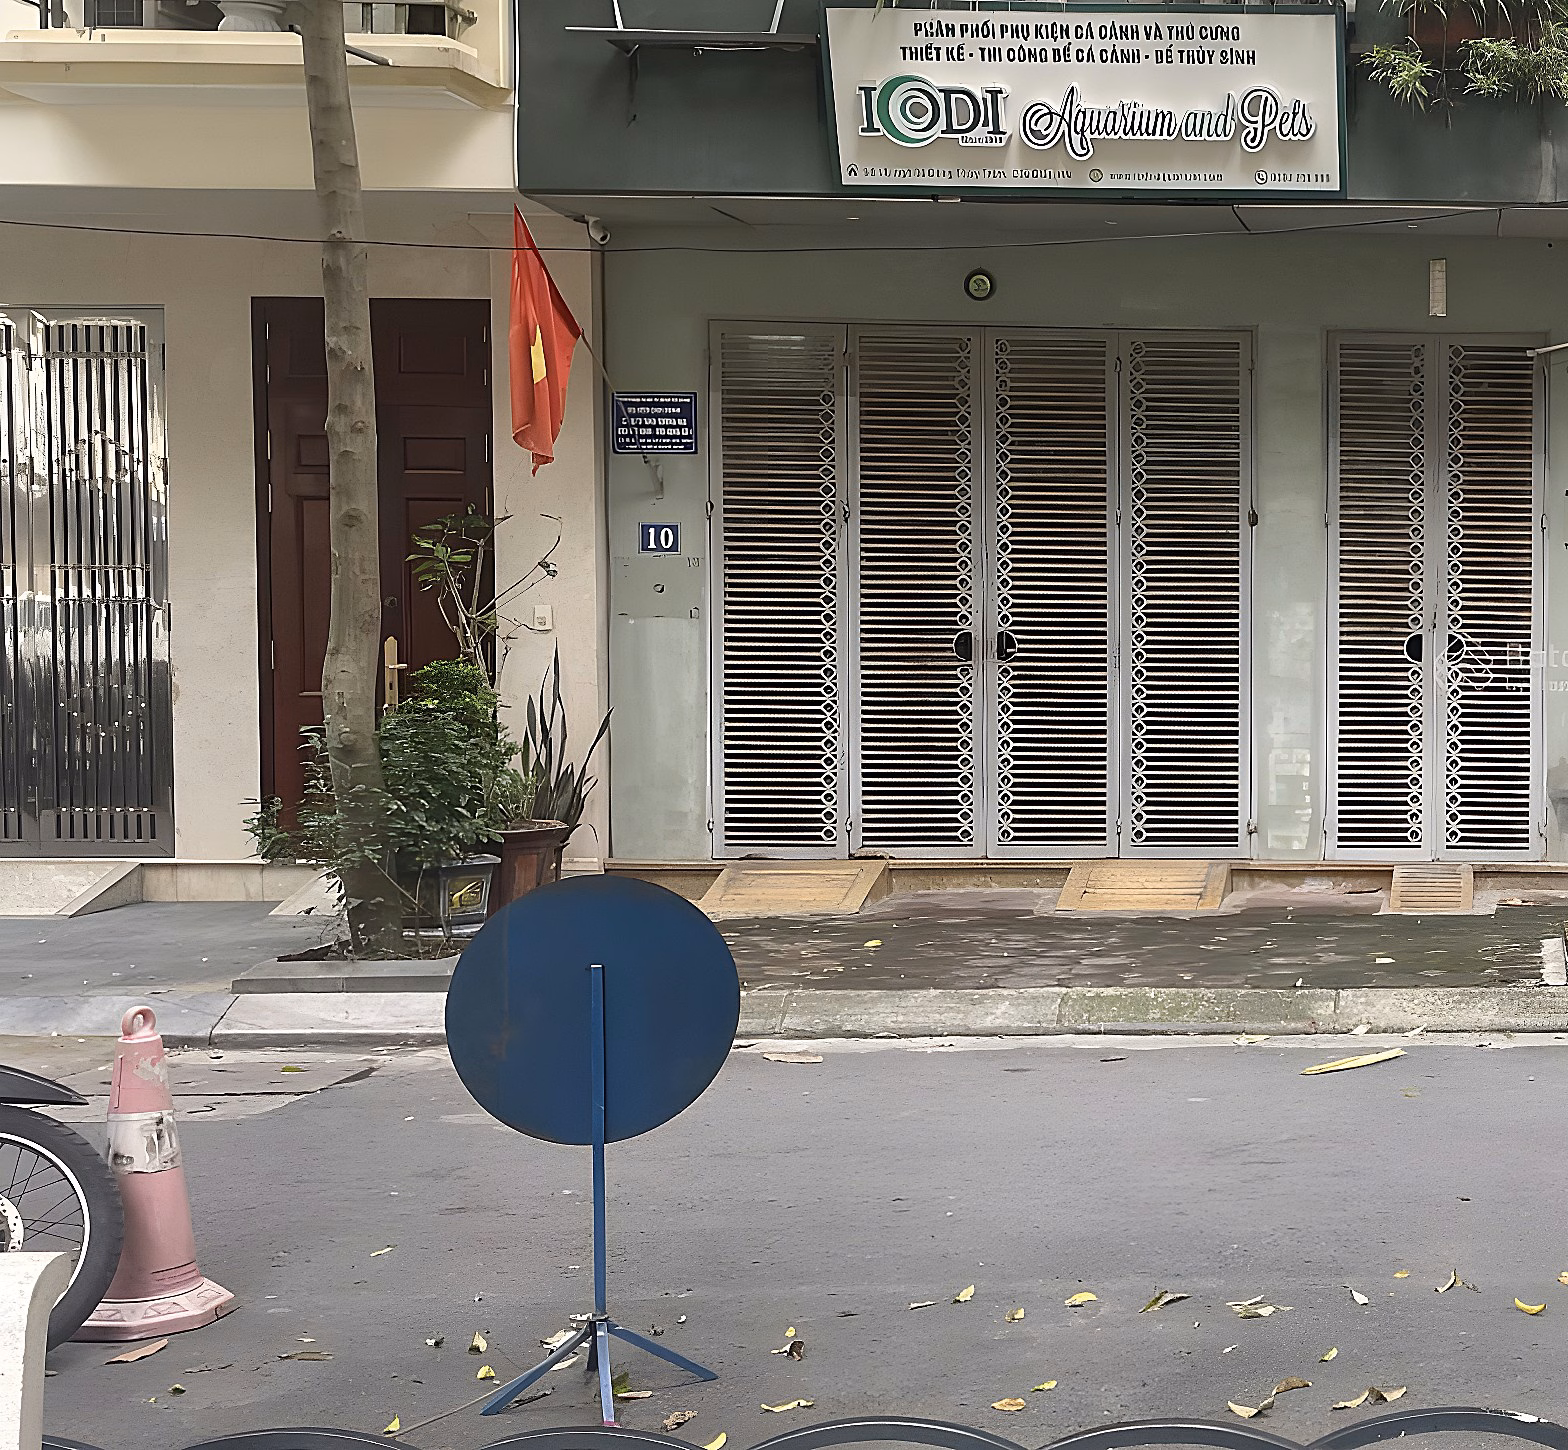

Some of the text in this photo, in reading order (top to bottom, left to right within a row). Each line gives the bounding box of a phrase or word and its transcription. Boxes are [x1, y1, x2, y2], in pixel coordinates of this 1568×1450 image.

[1021, 84, 1177, 158] Aquarium
[1182, 93, 1236, 139] and
[1240, 88, 1315, 151] Pets
[647, 527, 674, 549] 10
